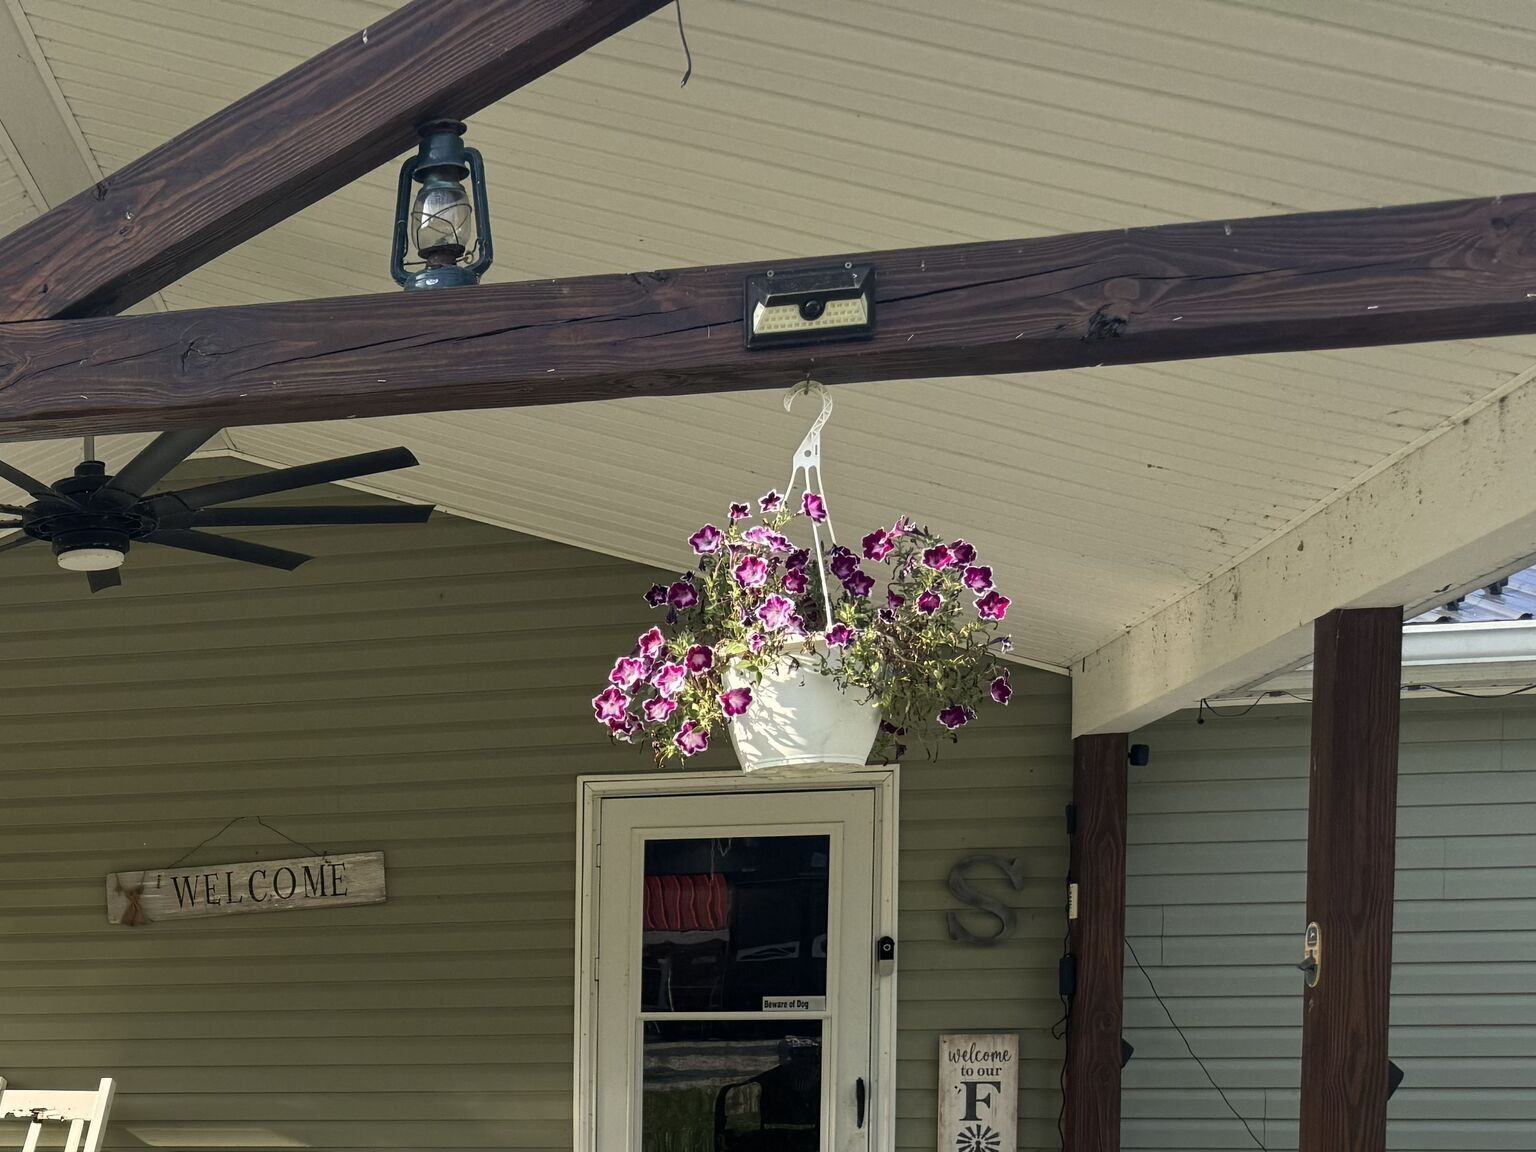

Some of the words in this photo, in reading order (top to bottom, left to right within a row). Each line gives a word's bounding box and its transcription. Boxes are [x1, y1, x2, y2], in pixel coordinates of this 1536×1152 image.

[170, 862, 348, 909] WELCOME
[947, 855, 1024, 947] S
[764, 1000, 788, 1009] Beware
[789, 1000, 796, 1008] of
[797, 1000, 809, 1009] Dog
[948, 1042, 1012, 1063] welcome
[961, 1065, 974, 1076] to
[977, 1067, 1002, 1076] our
